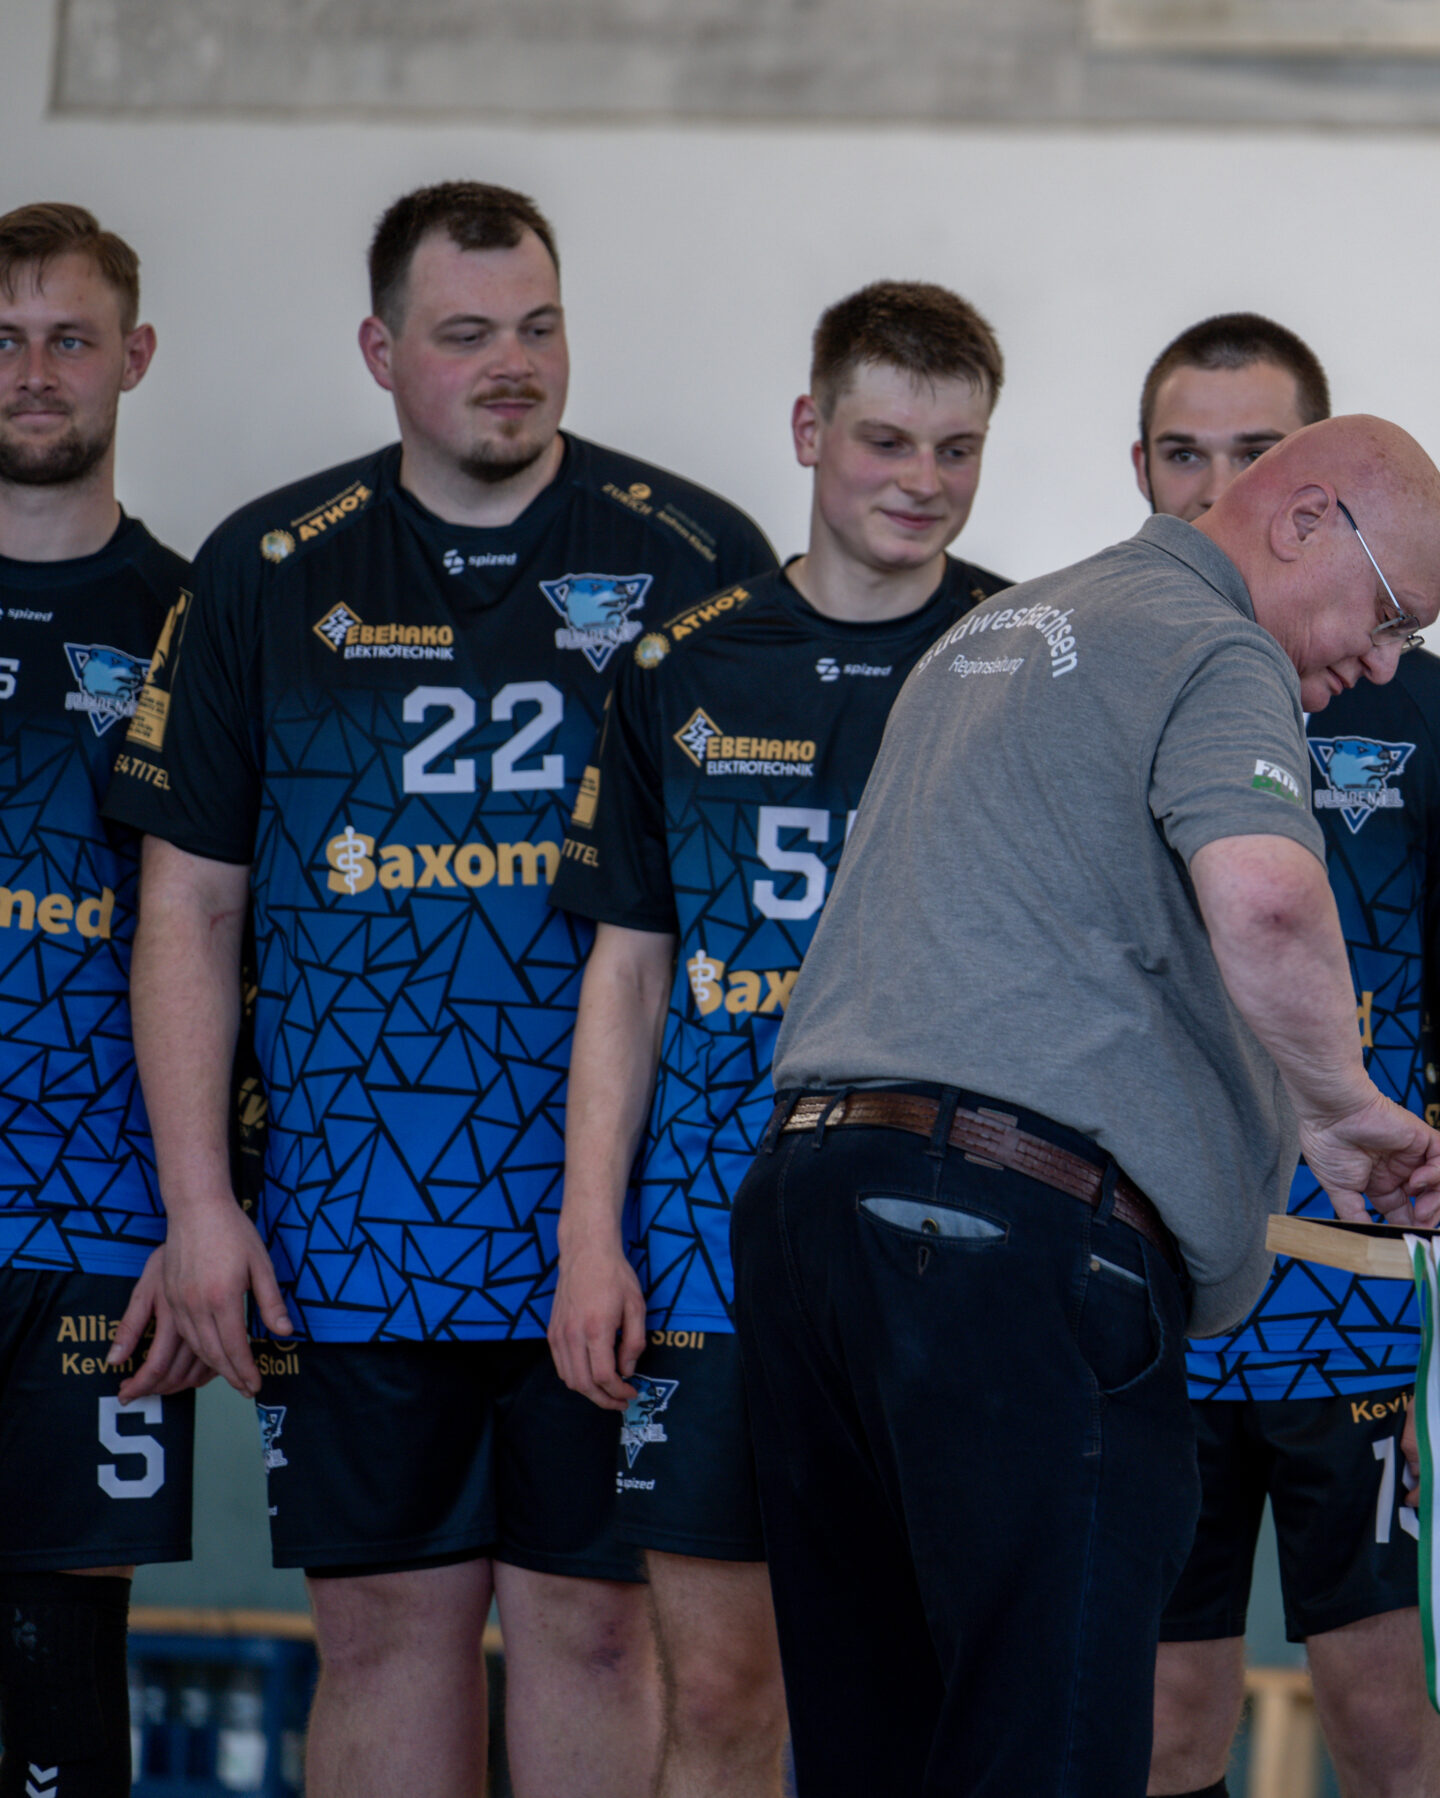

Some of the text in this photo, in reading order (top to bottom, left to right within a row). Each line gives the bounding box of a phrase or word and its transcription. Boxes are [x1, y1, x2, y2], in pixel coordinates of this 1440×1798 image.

[468, 552, 517, 567] spized
[7, 607, 53, 623] spized
[345, 623, 454, 646] EBEHAKO
[344, 644, 454, 660] ELEKTROTECHNIK
[843, 662, 893, 677] spized
[402, 680, 565, 794] 22
[706, 737, 816, 762] EBEHAKO
[706, 761, 814, 777] ELEKTROTECHNIK
[1254, 759, 1301, 798] FAIR
[753, 805, 858, 920] 5
[1350, 1391, 1414, 1424] Kevi
[97, 1396, 165, 1499] 5
